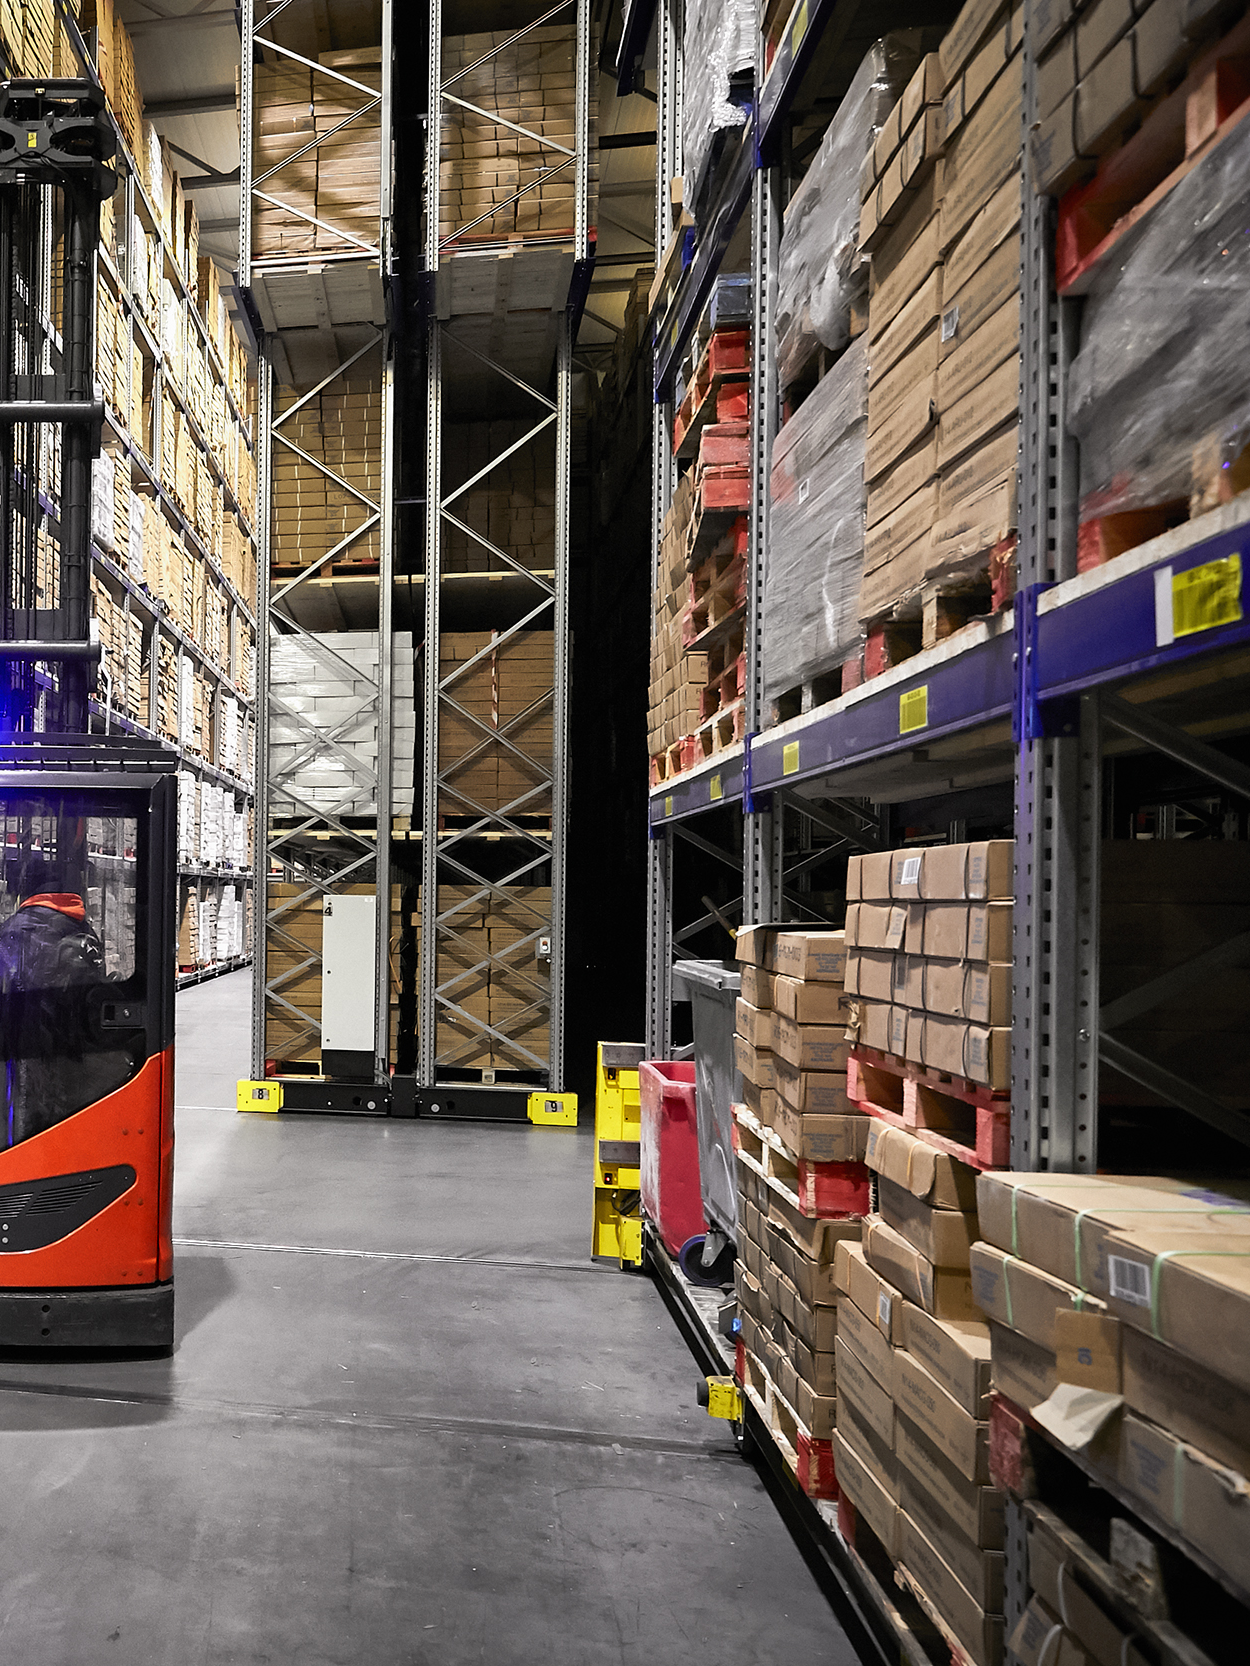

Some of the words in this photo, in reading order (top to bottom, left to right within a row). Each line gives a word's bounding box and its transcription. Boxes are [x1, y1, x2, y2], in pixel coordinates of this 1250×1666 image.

[324, 907, 333, 916] 4
[258, 1088, 264, 1100] 8
[551, 1101, 558, 1112] 9
